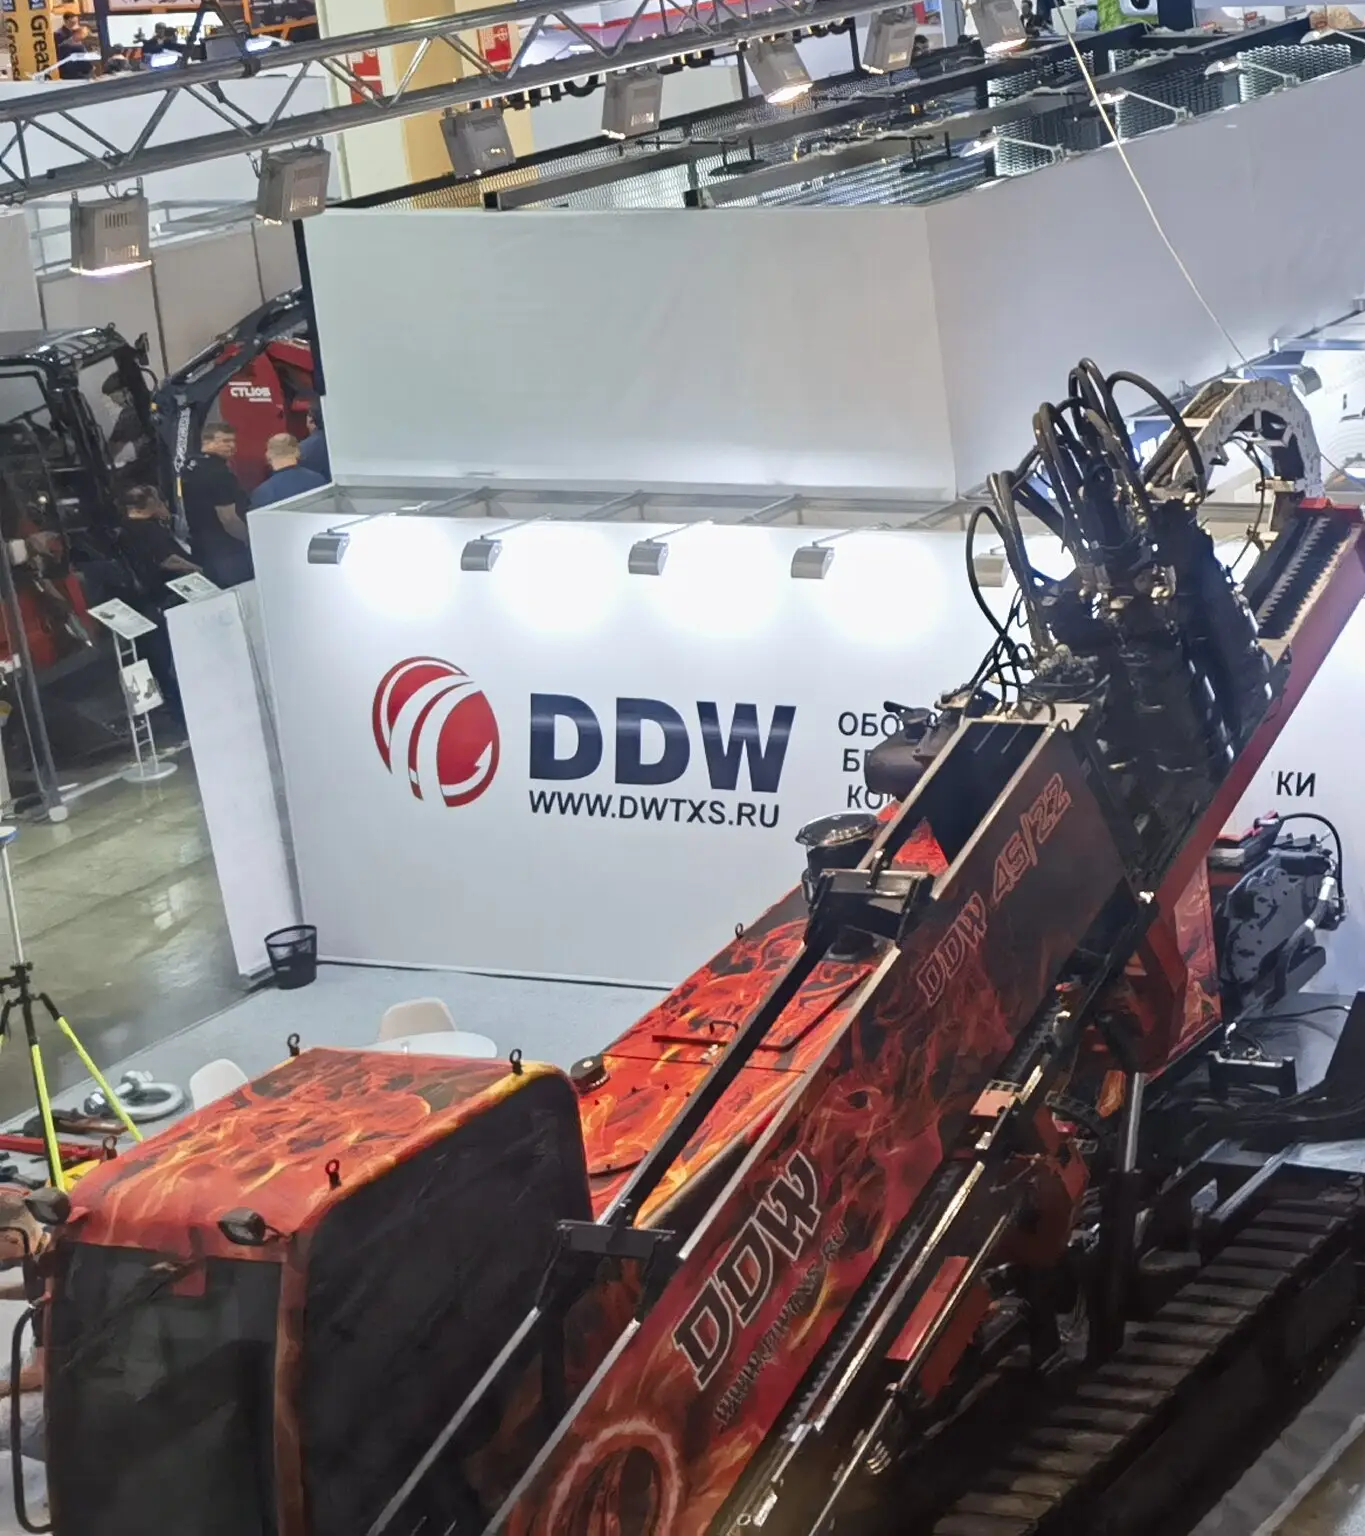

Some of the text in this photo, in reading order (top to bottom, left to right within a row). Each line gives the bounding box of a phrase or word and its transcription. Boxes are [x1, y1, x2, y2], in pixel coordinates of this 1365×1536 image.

[530, 692, 797, 793] DDW
[529, 789, 780, 828] WWW.DWTXS.RU
[914, 891, 988, 1005] DDW
[668, 1150, 824, 1392] DDW
